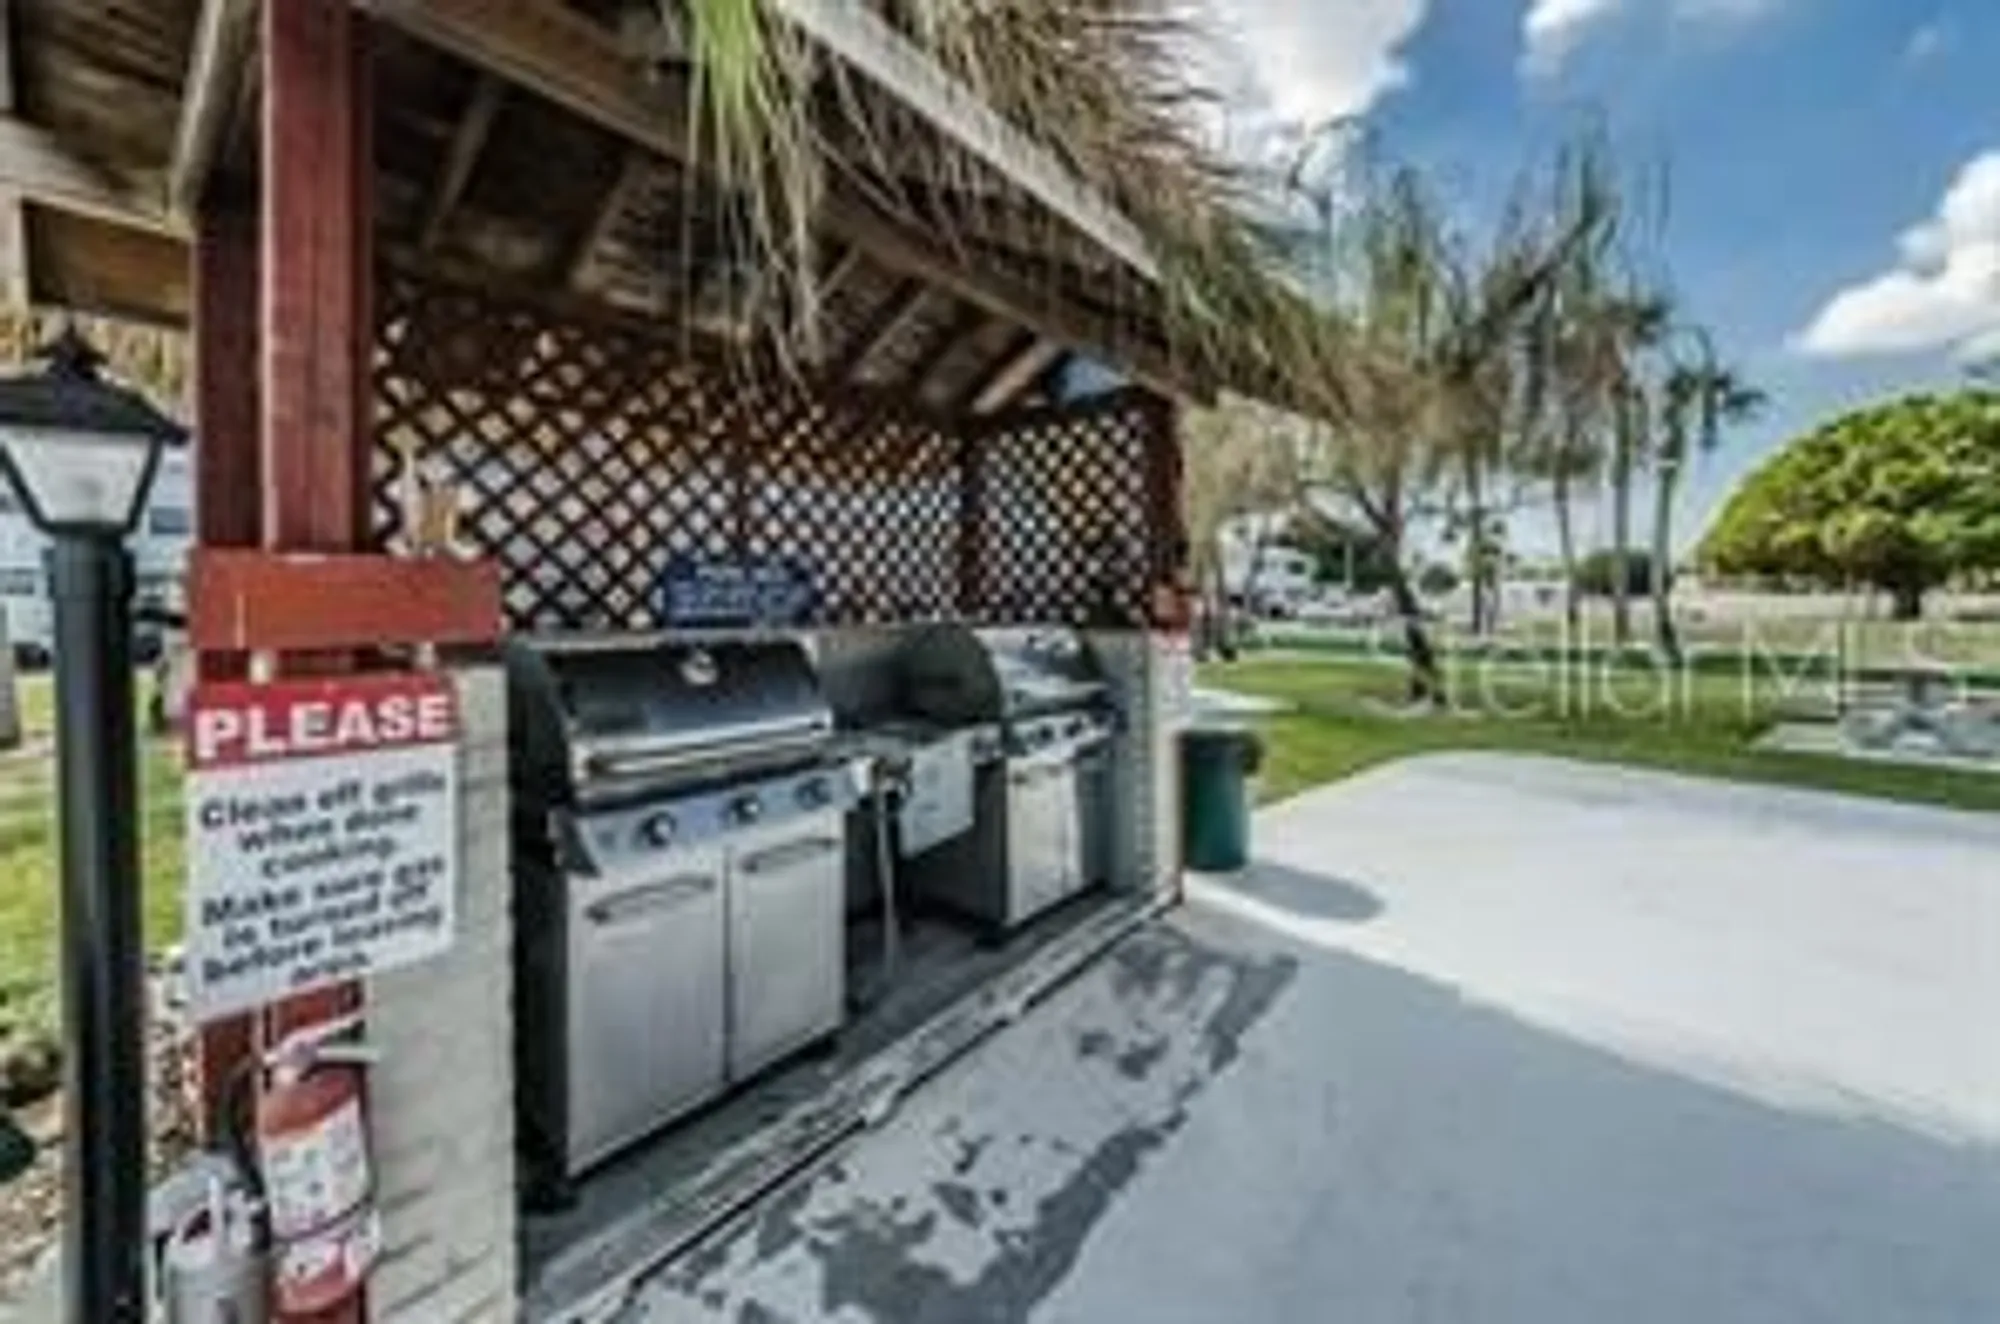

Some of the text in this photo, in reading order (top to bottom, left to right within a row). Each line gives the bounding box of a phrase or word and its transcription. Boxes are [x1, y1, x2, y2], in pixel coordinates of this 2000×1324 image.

[194, 694, 450, 759] PLEASE
[201, 795, 306, 830] Clean
[317, 782, 361, 811] off
[239, 804, 421, 852] when done
[202, 858, 444, 926] Make sure gas
[269, 889, 381, 938] turned
[389, 884, 428, 907] off
[331, 906, 442, 947] leaving
